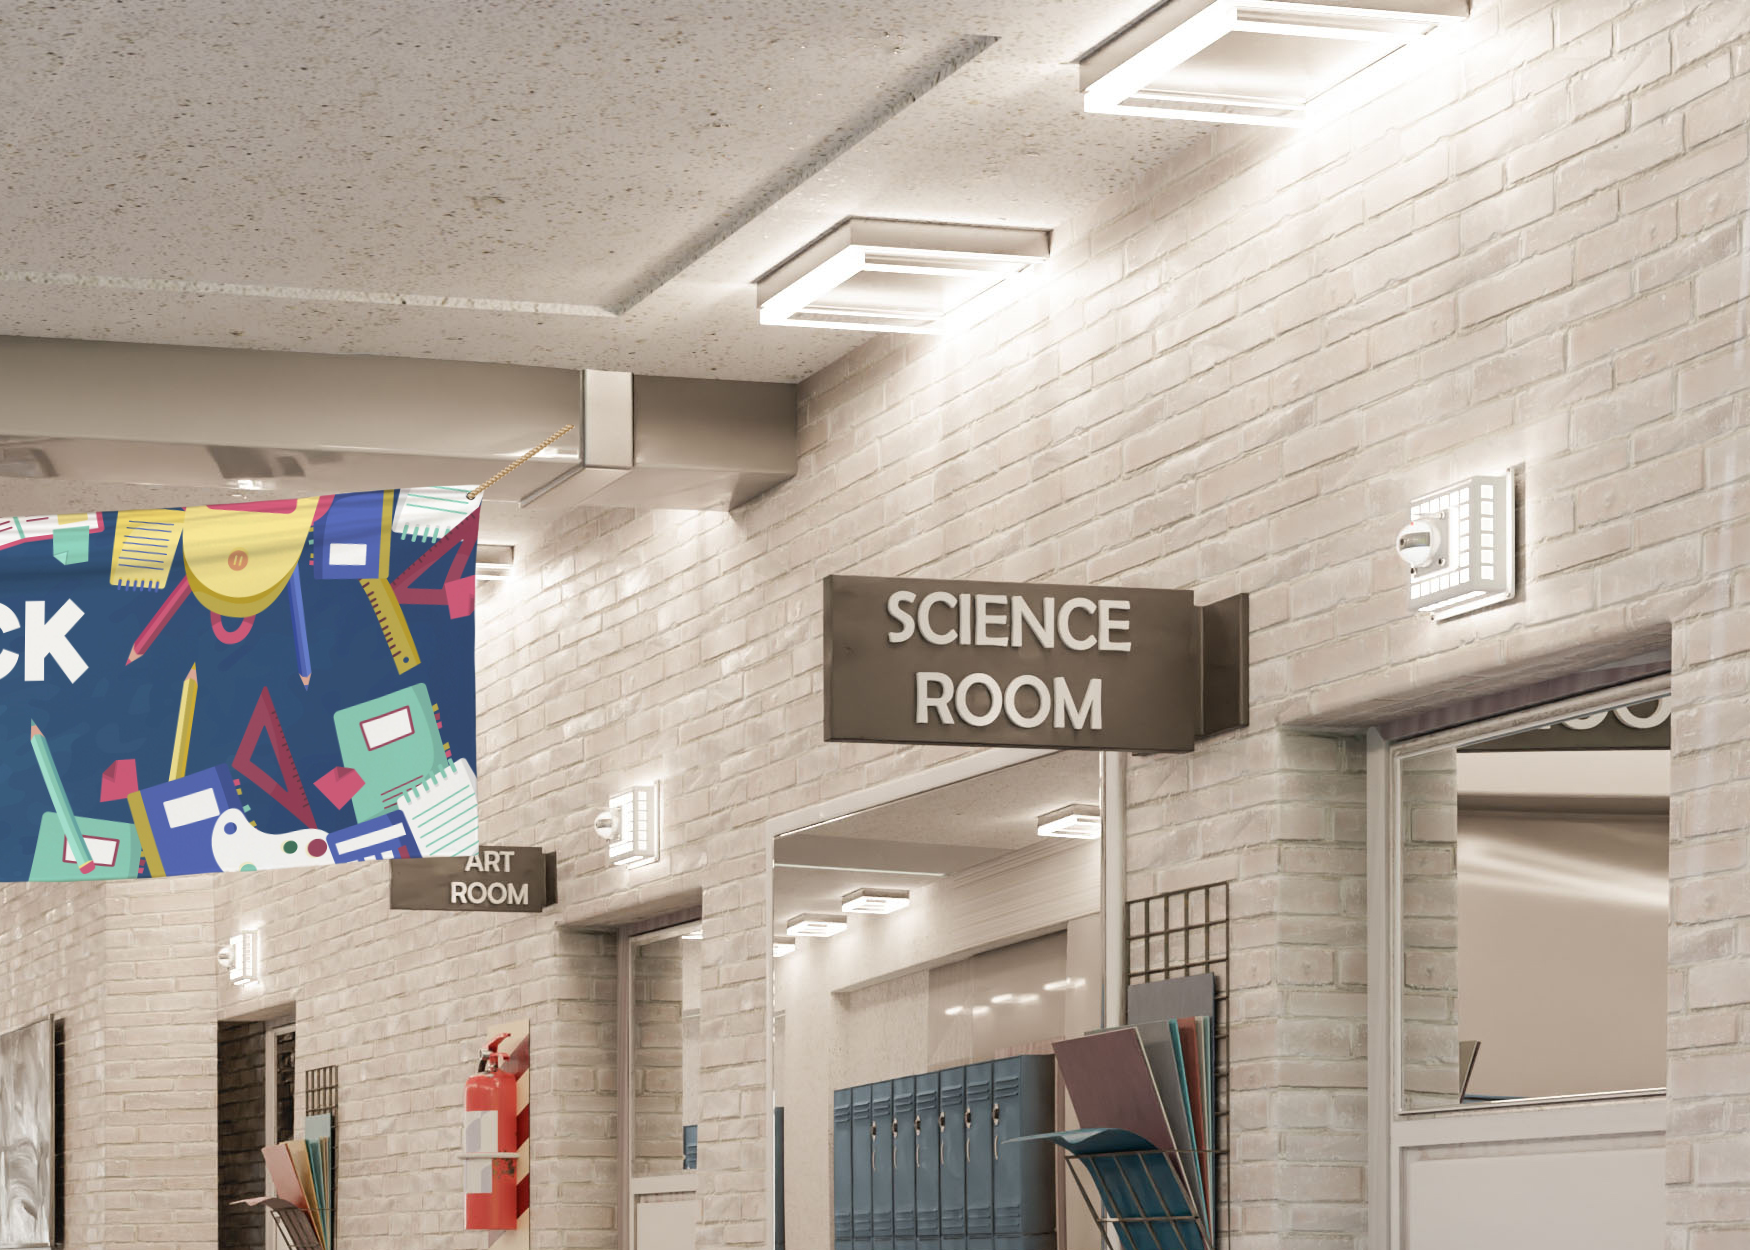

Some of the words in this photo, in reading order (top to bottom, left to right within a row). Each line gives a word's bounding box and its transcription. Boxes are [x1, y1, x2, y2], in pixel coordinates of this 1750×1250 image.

[886, 590, 1132, 652] SCIENCE
[915, 671, 1103, 730] ROOM
[464, 850, 515, 873] ART
[450, 881, 529, 905] ROOM
